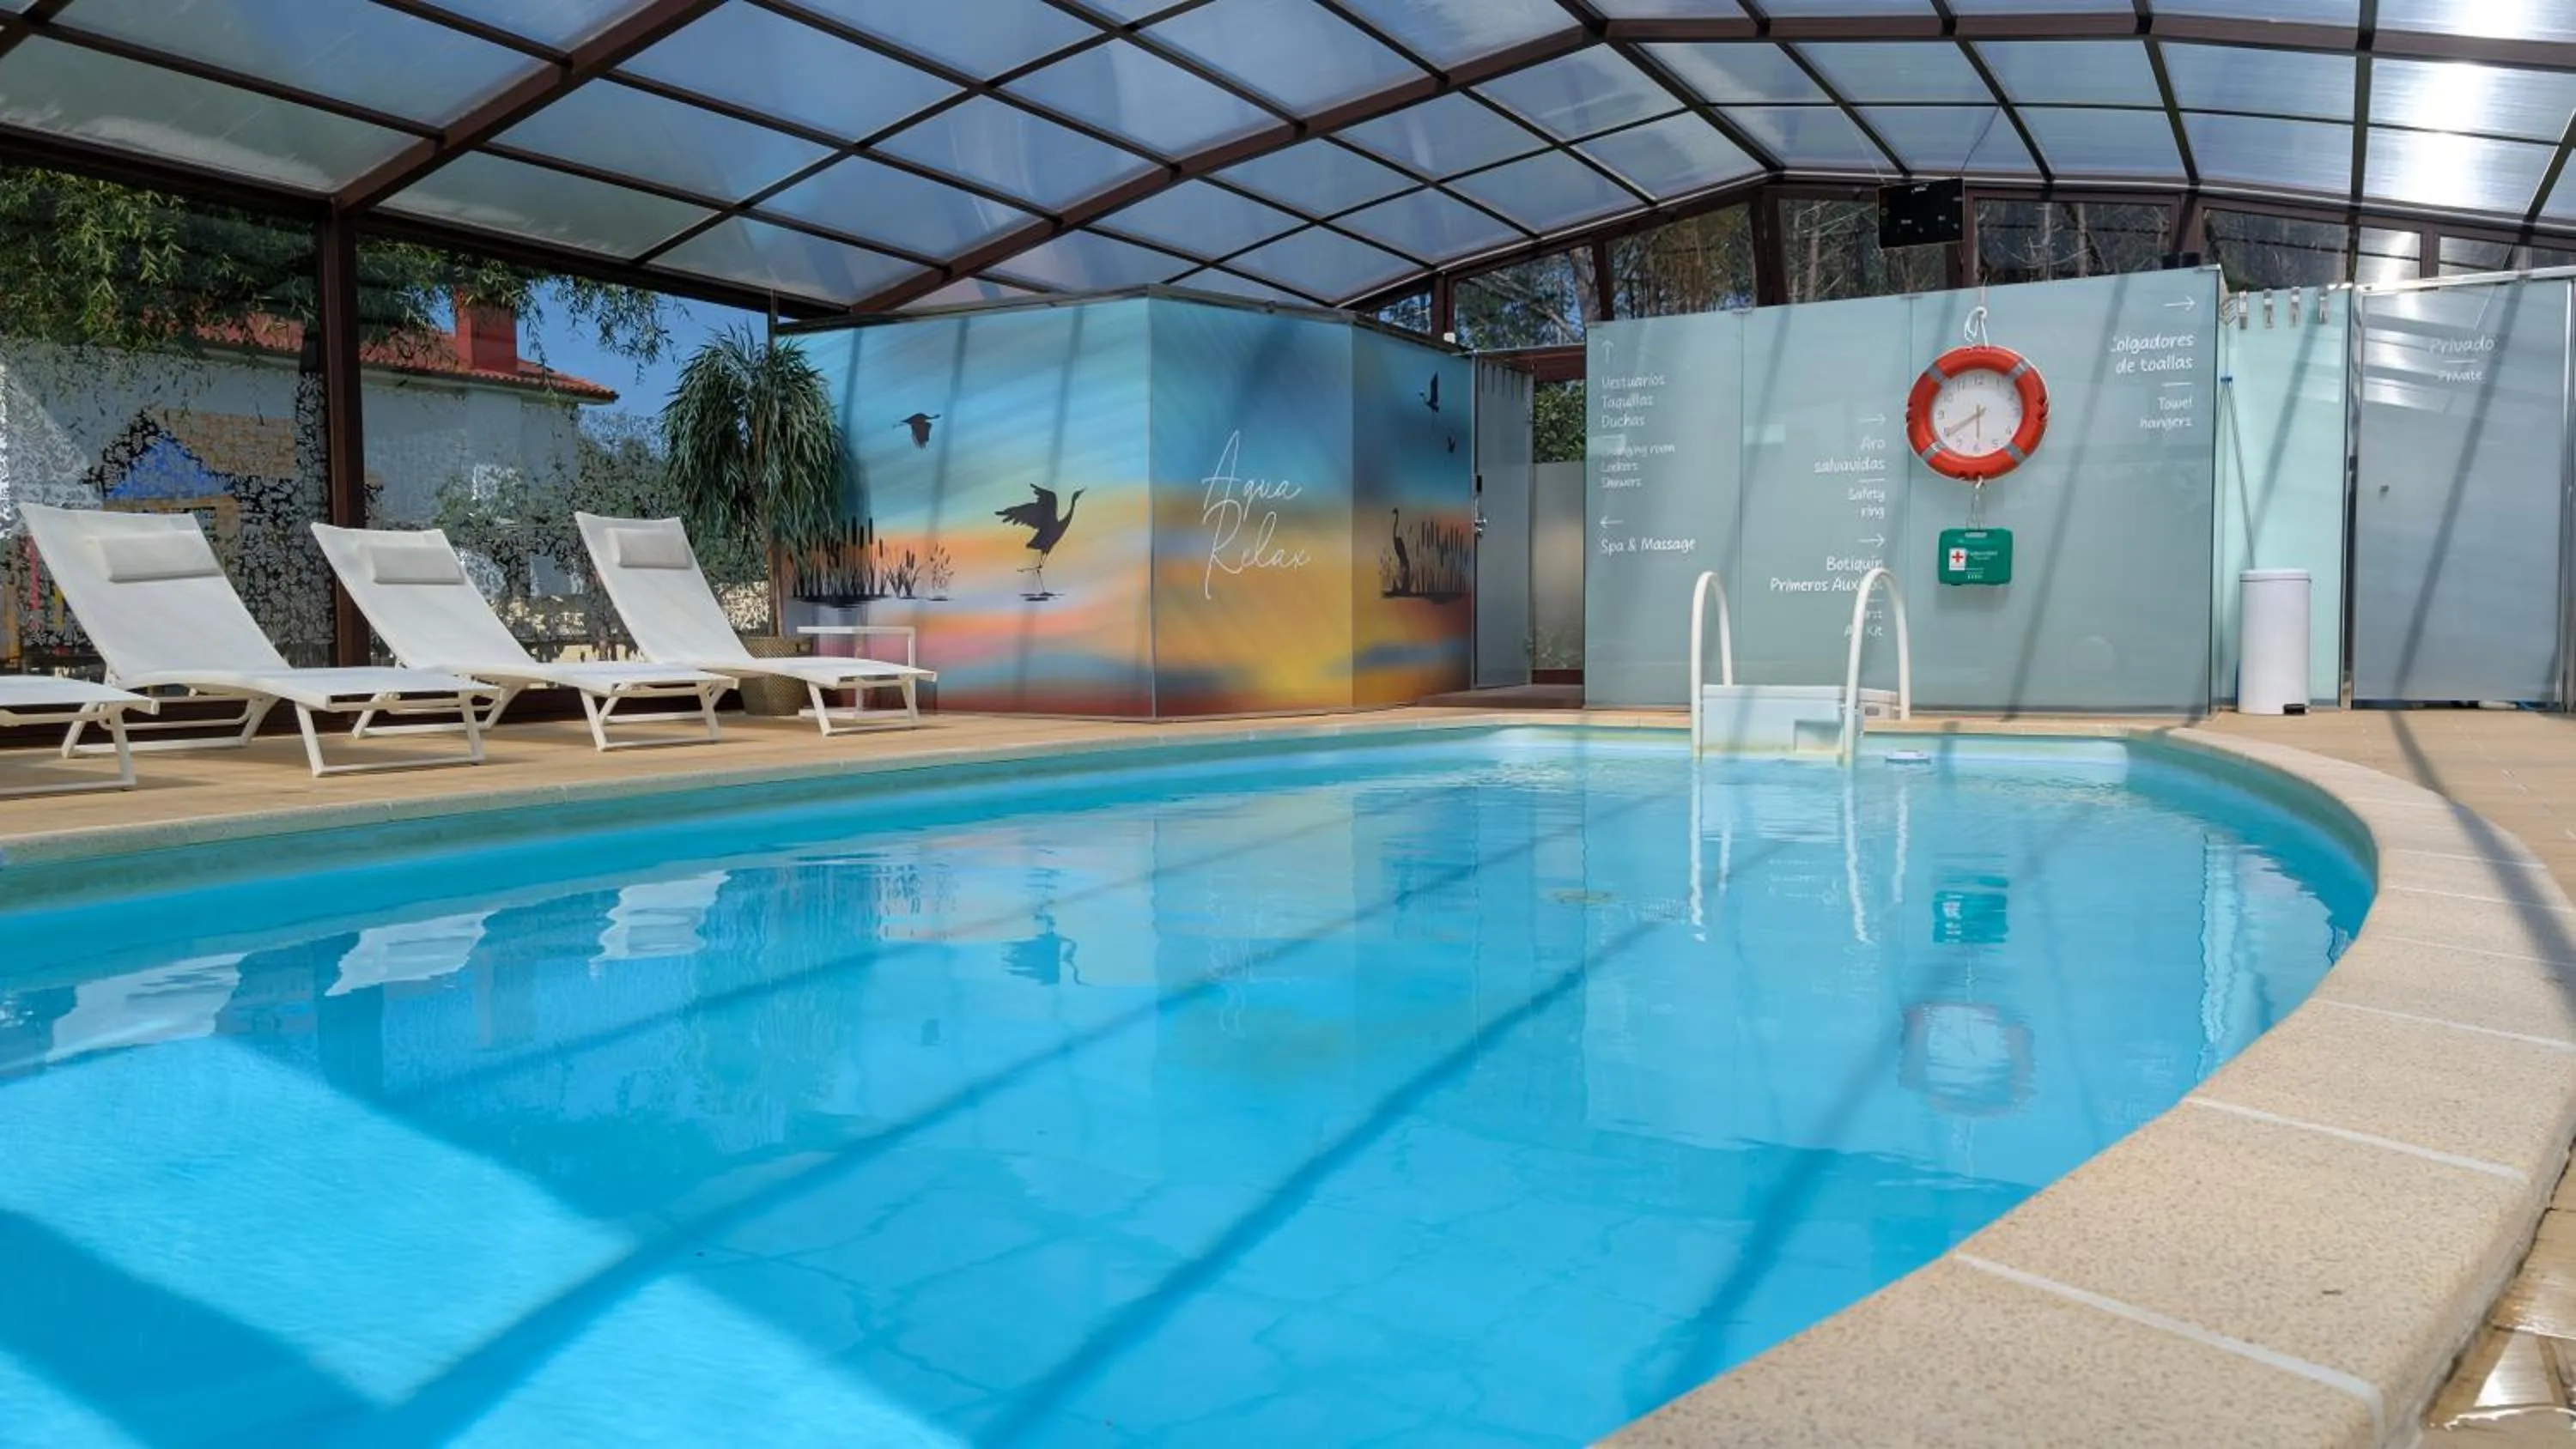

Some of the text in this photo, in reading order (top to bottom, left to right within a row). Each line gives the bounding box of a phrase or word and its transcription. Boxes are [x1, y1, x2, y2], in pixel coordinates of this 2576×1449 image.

[2429, 335, 2494, 354] Privado
[2116, 354, 2194, 374] de toallas
[1601, 373, 1665, 390] Vestuarios
[1601, 393, 1654, 409] Taquillas
[2158, 396, 2193, 410] Towel
[1601, 414, 1646, 428] Duchas
[2138, 416, 2192, 431] hangers
[1861, 435, 1886, 451] Aro
[1814, 457, 1885, 473] salvavidas
[1201, 429, 1303, 522] Aqua
[1848, 488, 1885, 502] Safety
[1861, 504, 1885, 520] ring
[1202, 499, 1310, 600] Relax
[1601, 537, 1697, 557] Spa & Massage
[1770, 577, 1828, 592] Primeros
